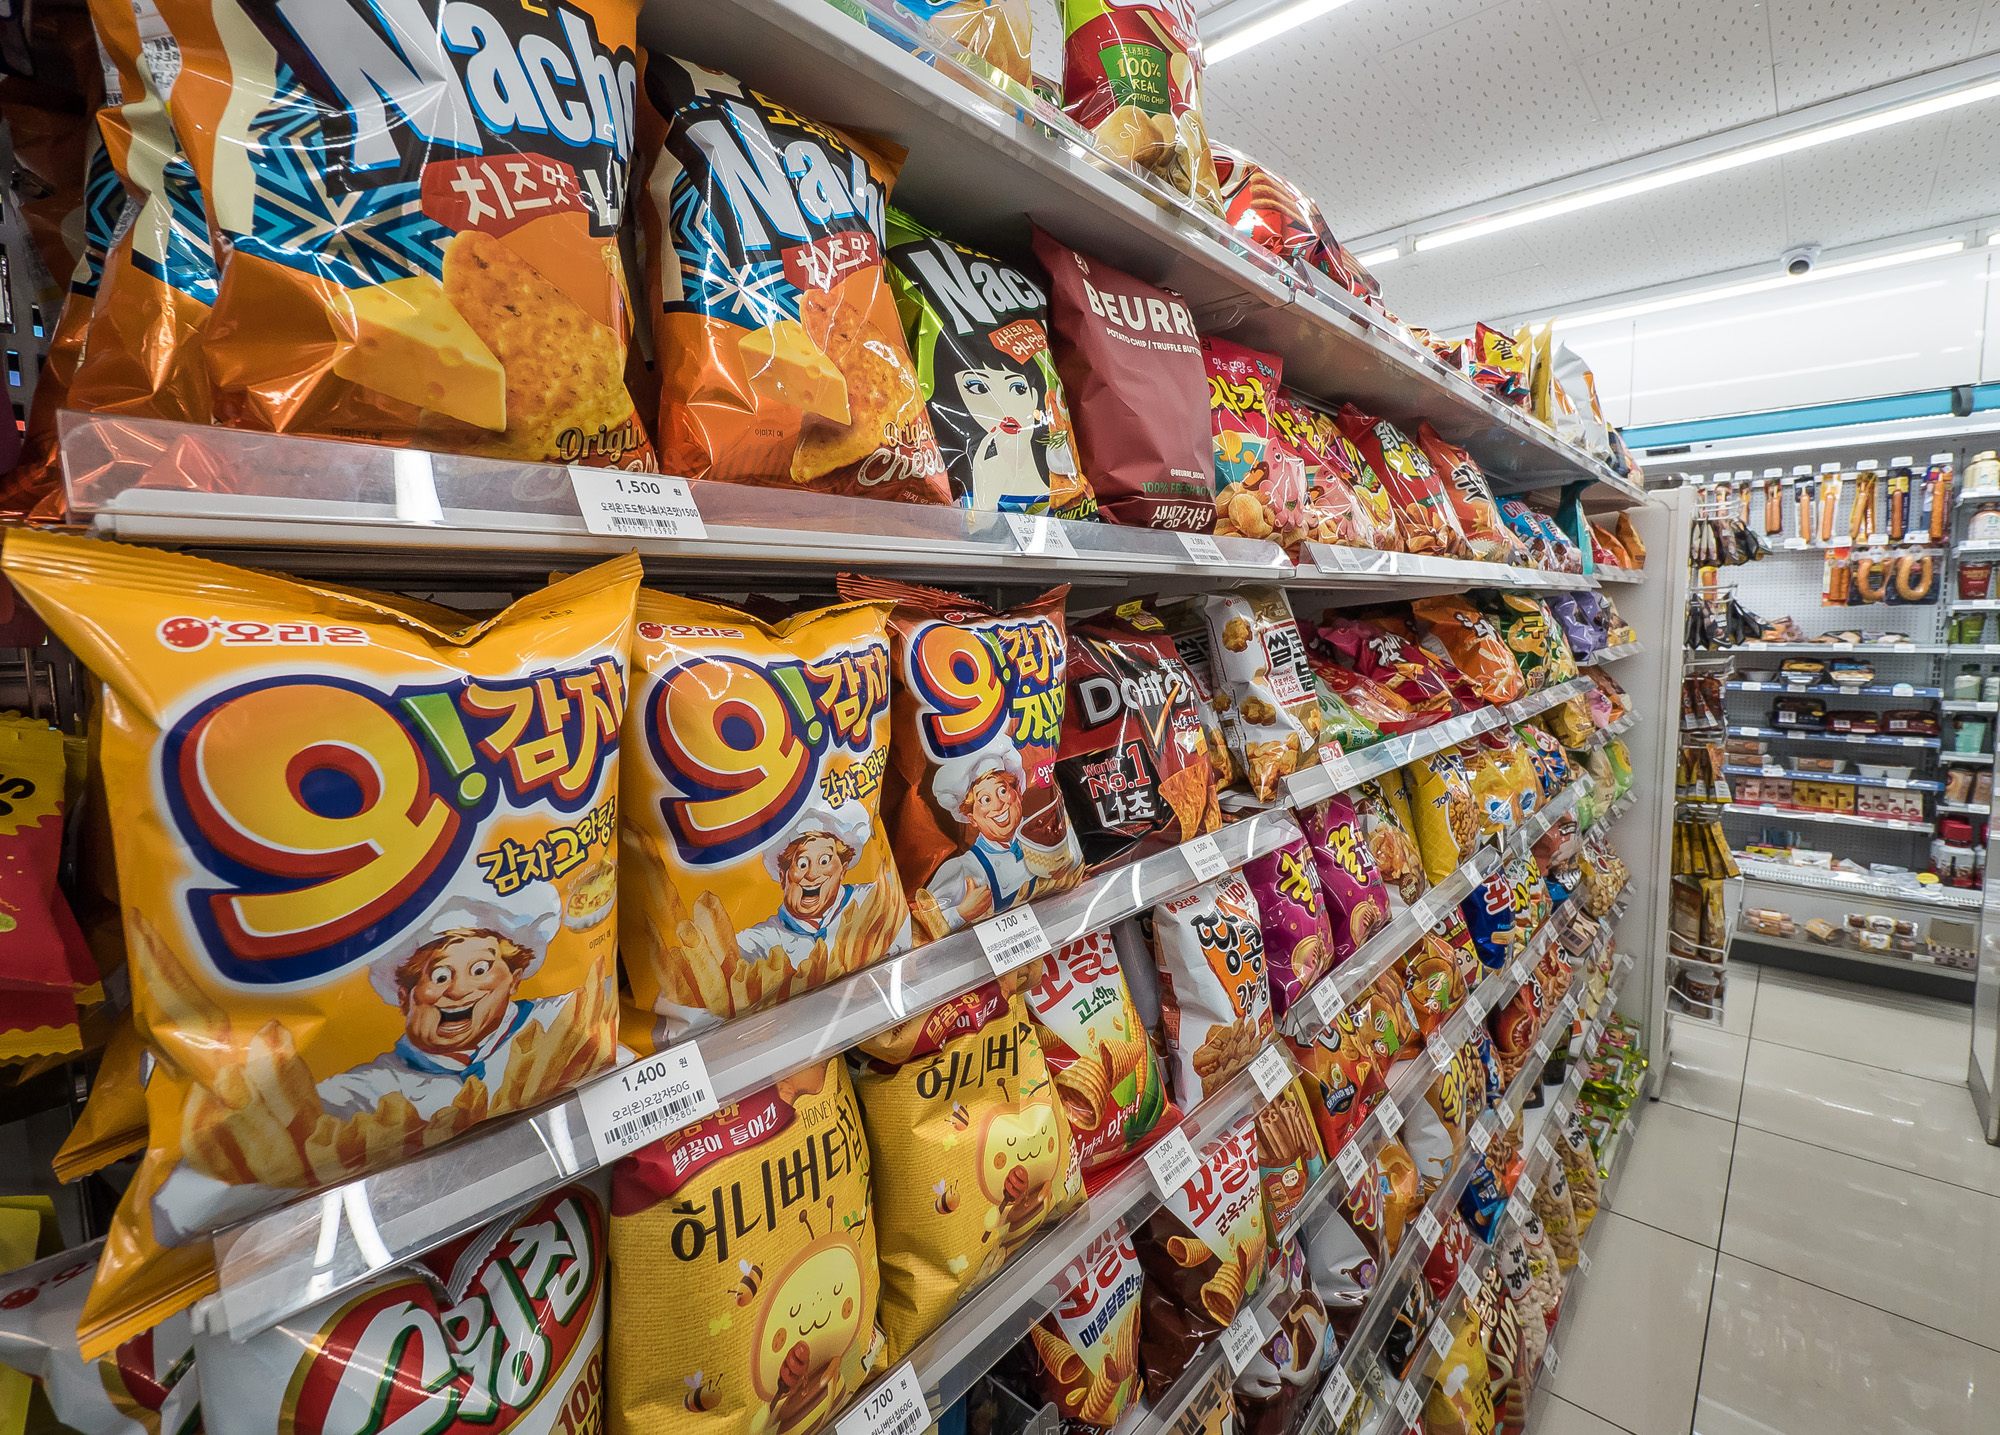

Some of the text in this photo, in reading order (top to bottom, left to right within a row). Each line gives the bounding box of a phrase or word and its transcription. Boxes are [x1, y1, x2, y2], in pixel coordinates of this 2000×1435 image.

[1116, 57, 1162, 79] 100%
[1132, 78, 1160, 94] REAL
[450, 161, 572, 226] 치즈맛
[1106, 326, 1132, 345] POTATO
[1129, 336, 1147, 350] CHIP
[1152, 341, 1181, 353] TRUFFLE
[615, 478, 682, 497] 1,500 원
[1142, 481, 1169, 494] 100%
[1170, 483, 1195, 496] FRESH
[225, 622, 370, 645] 오리온
[668, 623, 744, 640] 오리온
[1083, 756, 1118, 778] World
[1096, 789, 1155, 829] 나쵸
[1174, 894, 1201, 909] 오리온
[995, 914, 1018, 932] 1,700
[1071, 985, 1120, 1026] 고소한맛
[622, 1057, 689, 1092] 1,400 원
[916, 1021, 1033, 1102] 허니버
[611, 1080, 691, 1123] 오리온)오감자50G
[801, 1098, 833, 1130] HONEY
[620, 1108, 698, 1147] 8801117752804
[671, 1133, 724, 1177] 벌꿀이
[729, 1102, 778, 1147] 들어간
[863, 1379, 908, 1422] 1,700 원
